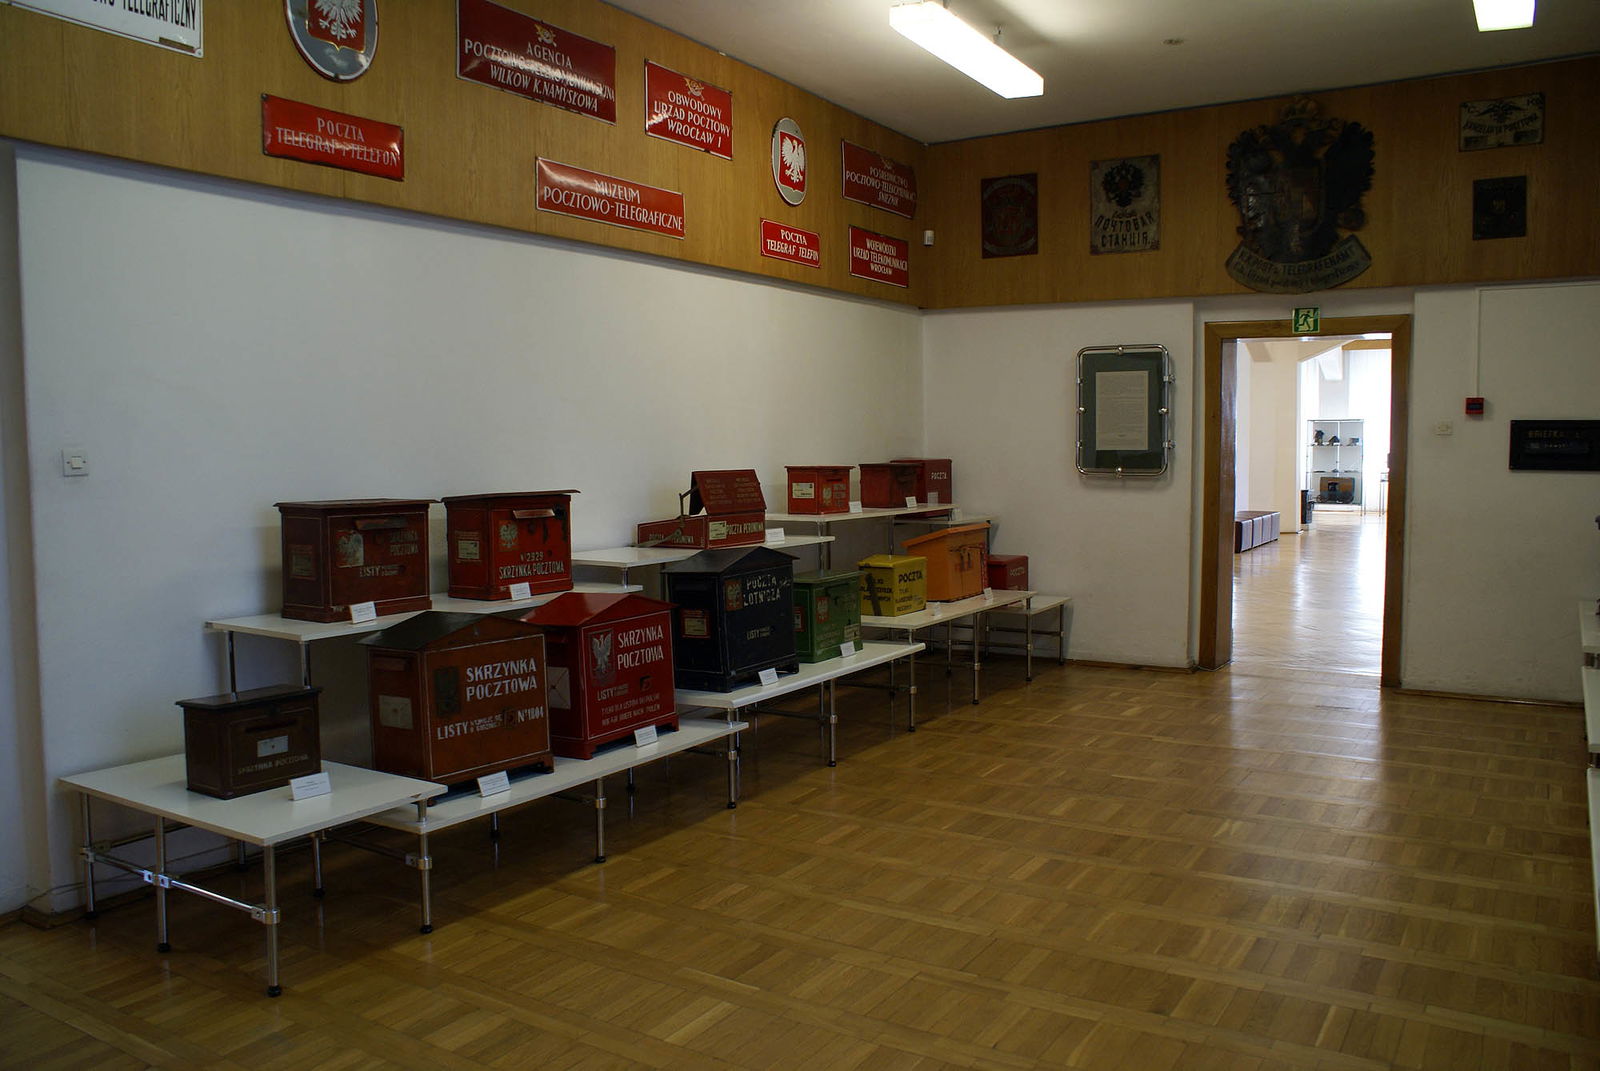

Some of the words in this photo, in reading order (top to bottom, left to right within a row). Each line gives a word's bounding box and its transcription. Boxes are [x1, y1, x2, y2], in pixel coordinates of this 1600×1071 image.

[667, 90, 723, 121] OBWODOWY
[317, 117, 365, 143] POCZTA
[687, 111, 731, 138] POCZTOWY
[275, 126, 336, 155] TELEGRAF
[350, 144, 399, 168] TELEFON
[594, 180, 641, 205] MUZEUM
[543, 186, 684, 232] POCZTOWO-TELEGRAFICZNE
[766, 238, 797, 258] TELEGRAF
[798, 245, 820, 263] TELEFON
[780, 228, 808, 247] POCZTA
[498, 564, 532, 580] SKRZYNKA
[532, 560, 566, 577] POCZTOWA
[617, 624, 665, 649] SKRZYNKA
[466, 657, 538, 684] SKRZYNKA
[617, 645, 665, 671] POCZTOWA
[466, 675, 540, 702] POCZTOWA
[596, 686, 616, 702] LISTY
[436, 721, 471, 742] LISTY
